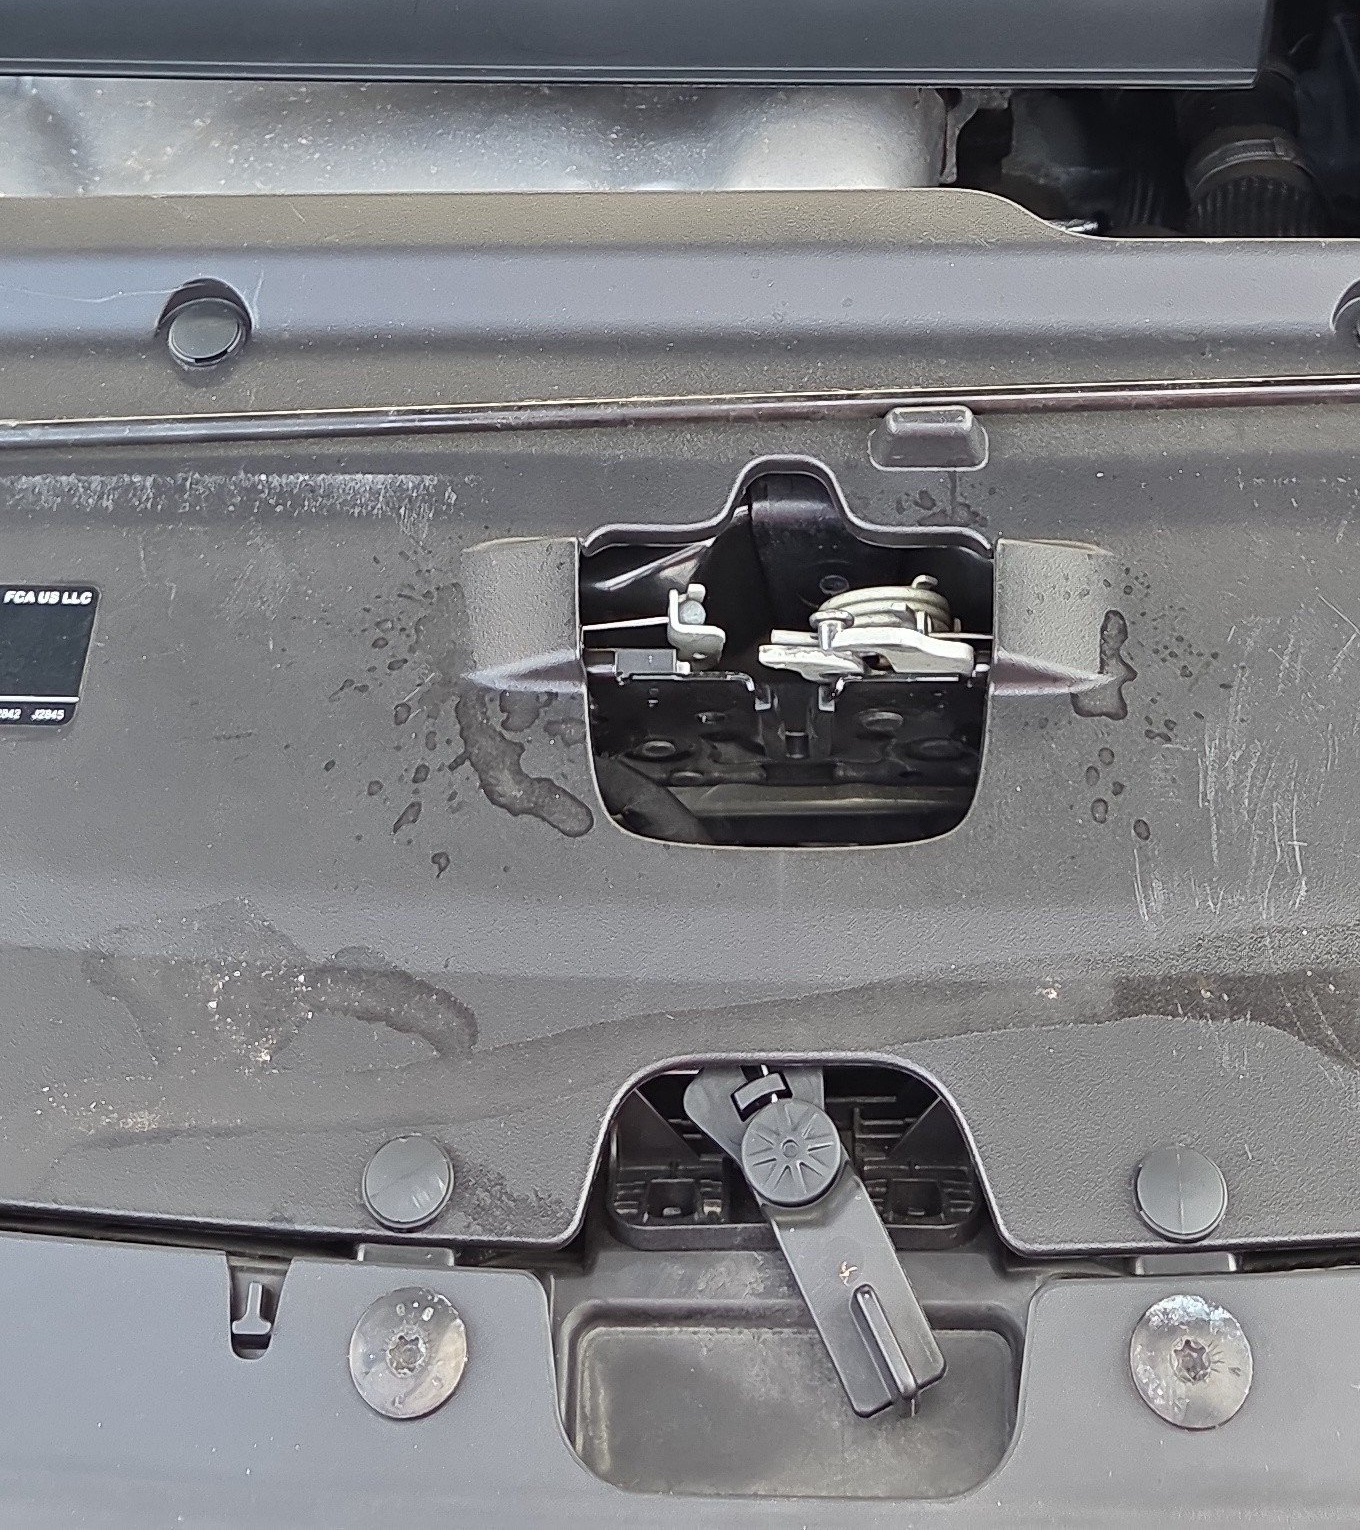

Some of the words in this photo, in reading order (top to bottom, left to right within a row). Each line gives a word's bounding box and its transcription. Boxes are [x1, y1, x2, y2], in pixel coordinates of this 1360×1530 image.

[2, 590, 36, 605] FCA
[37, 590, 61, 605] US
[61, 591, 93, 605] LLC
